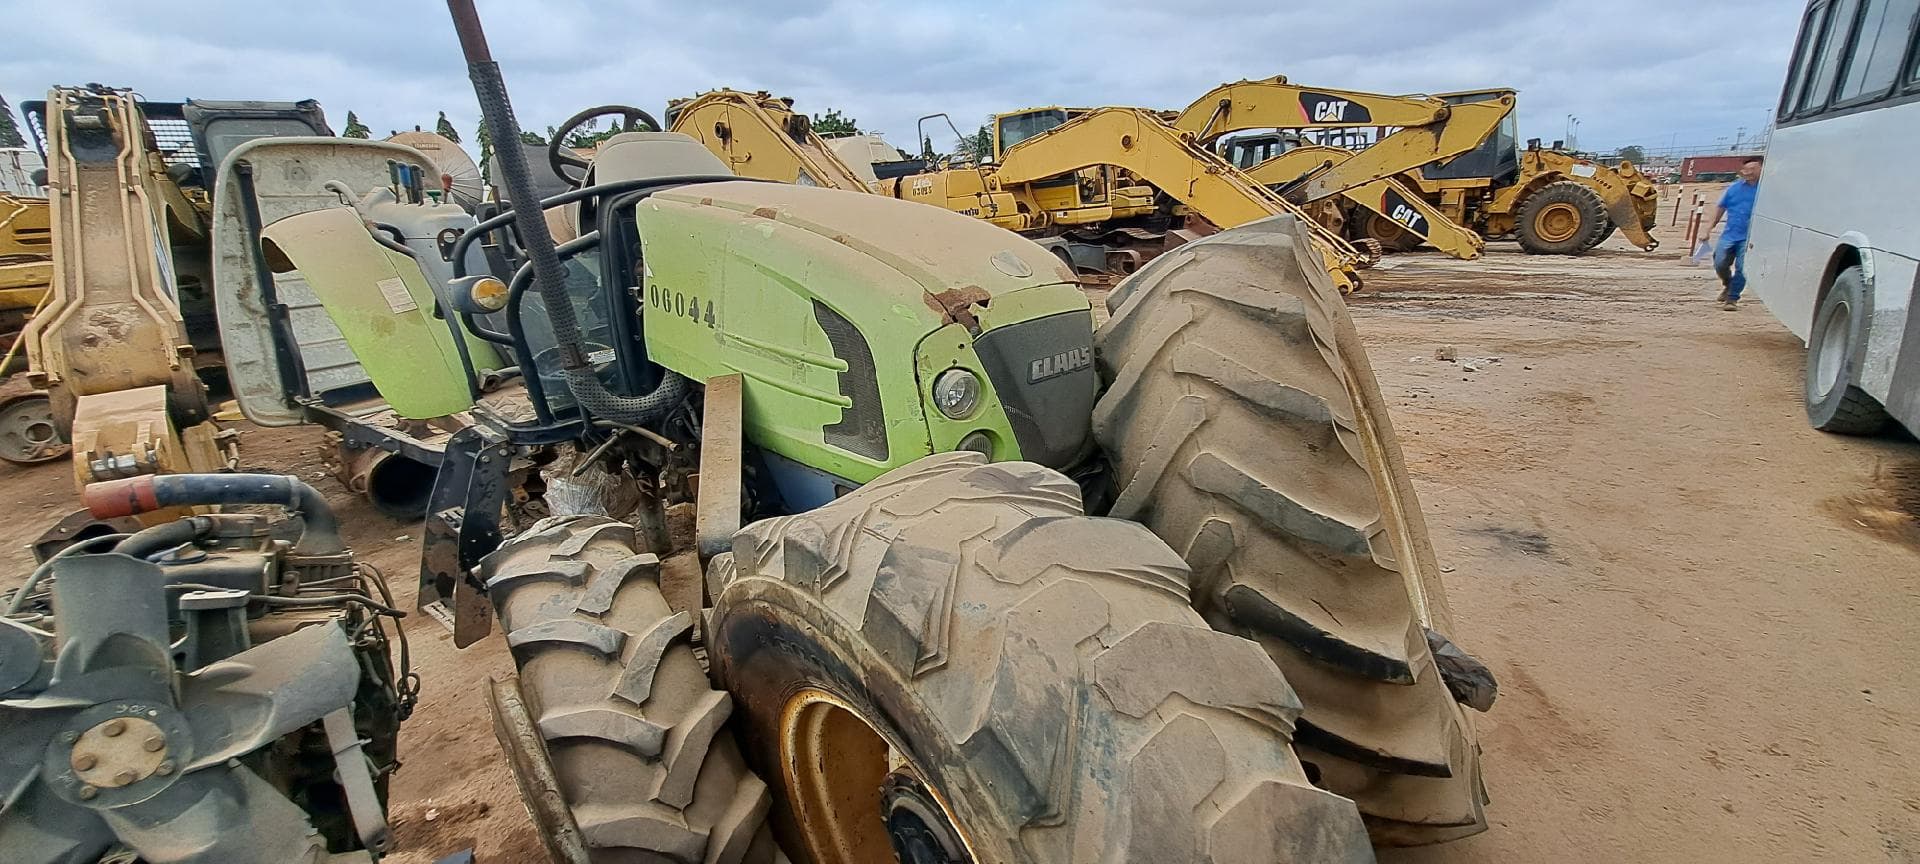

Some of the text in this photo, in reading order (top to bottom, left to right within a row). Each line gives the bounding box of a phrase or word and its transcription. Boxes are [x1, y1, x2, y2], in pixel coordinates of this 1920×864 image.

[1314, 101, 1349, 122] CAT
[955, 207, 980, 216] MATSU
[1391, 204, 1422, 228] CAT
[650, 284, 716, 330] 06044
[1031, 346, 1090, 380] CLAAS
